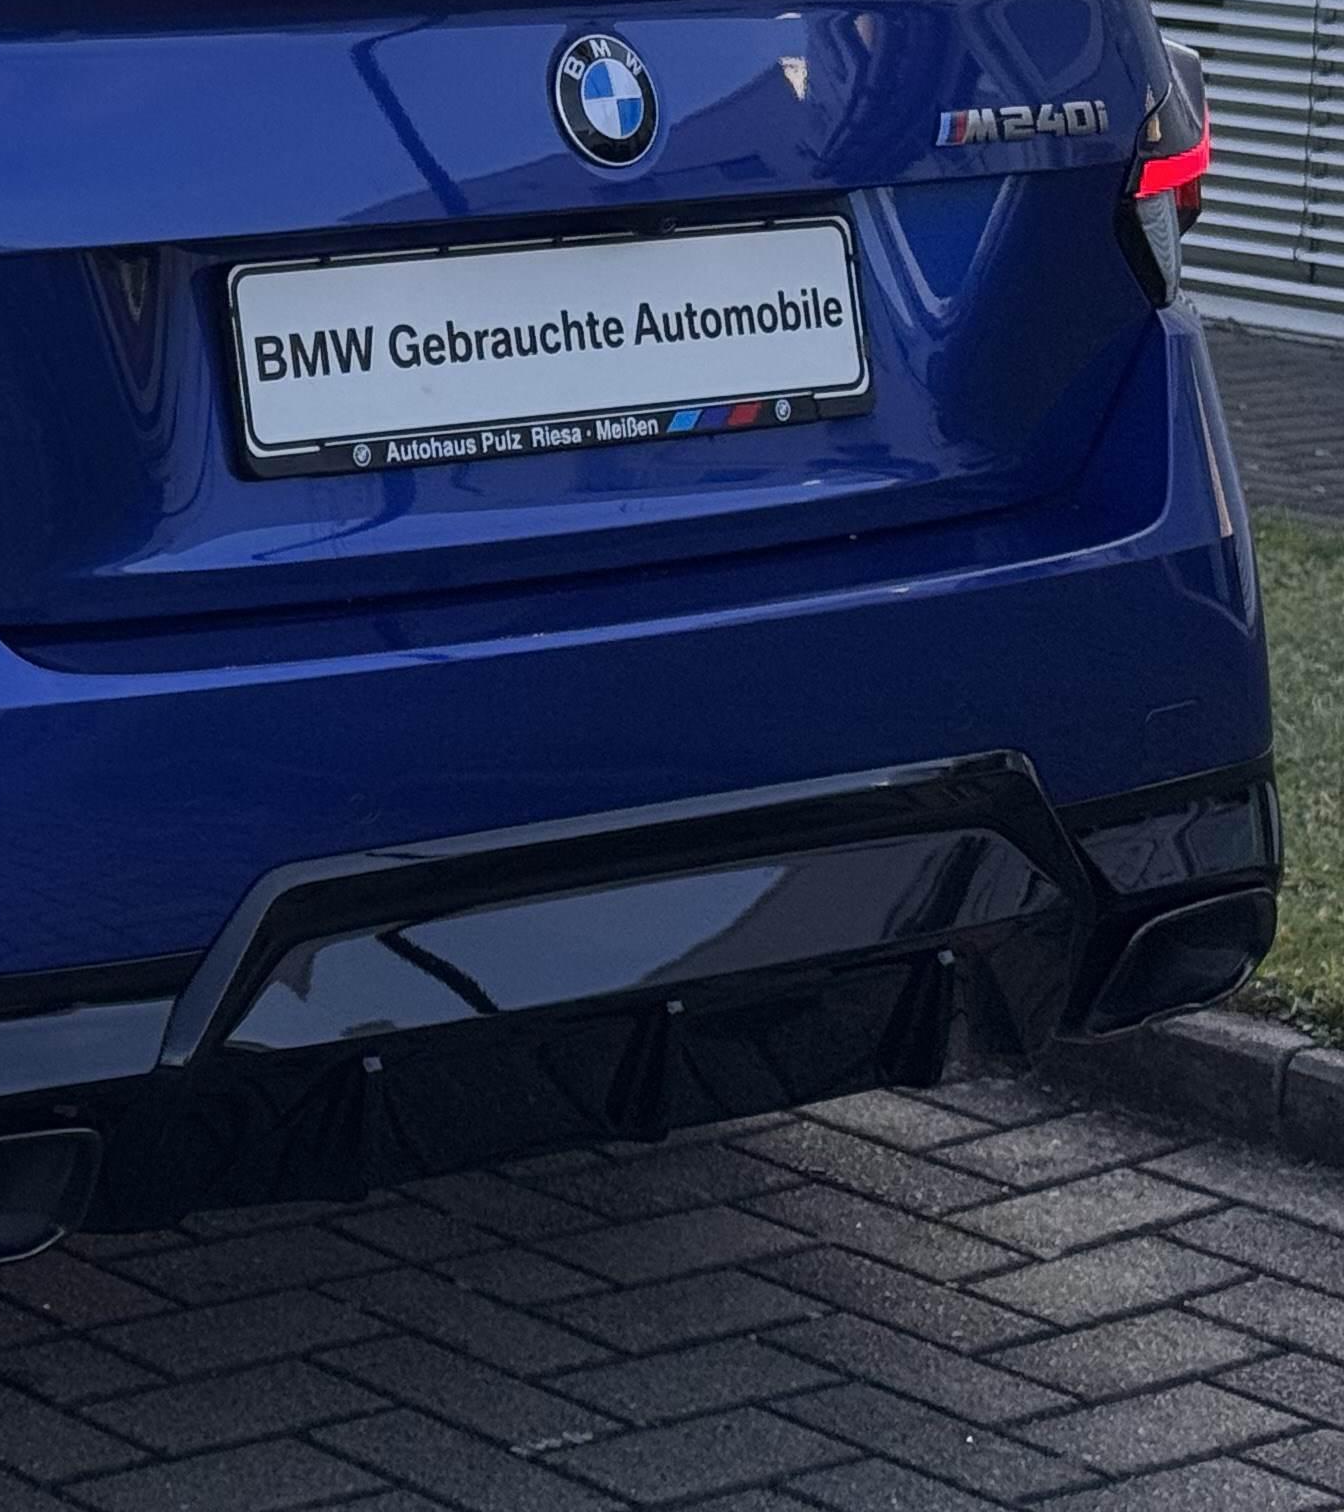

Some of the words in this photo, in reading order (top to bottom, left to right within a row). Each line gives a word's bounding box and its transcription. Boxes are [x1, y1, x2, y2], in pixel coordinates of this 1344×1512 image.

[564, 39, 643, 81] BMW
[965, 100, 1110, 145] M240i
[254, 325, 374, 382] BMW
[388, 309, 624, 369] Gebrauchte
[633, 287, 843, 345] Automobile
[386, 437, 477, 463] Autohaus
[481, 430, 523, 453] Pulz
[530, 425, 583, 448] Riesa
[595, 416, 659, 441] Meißen
